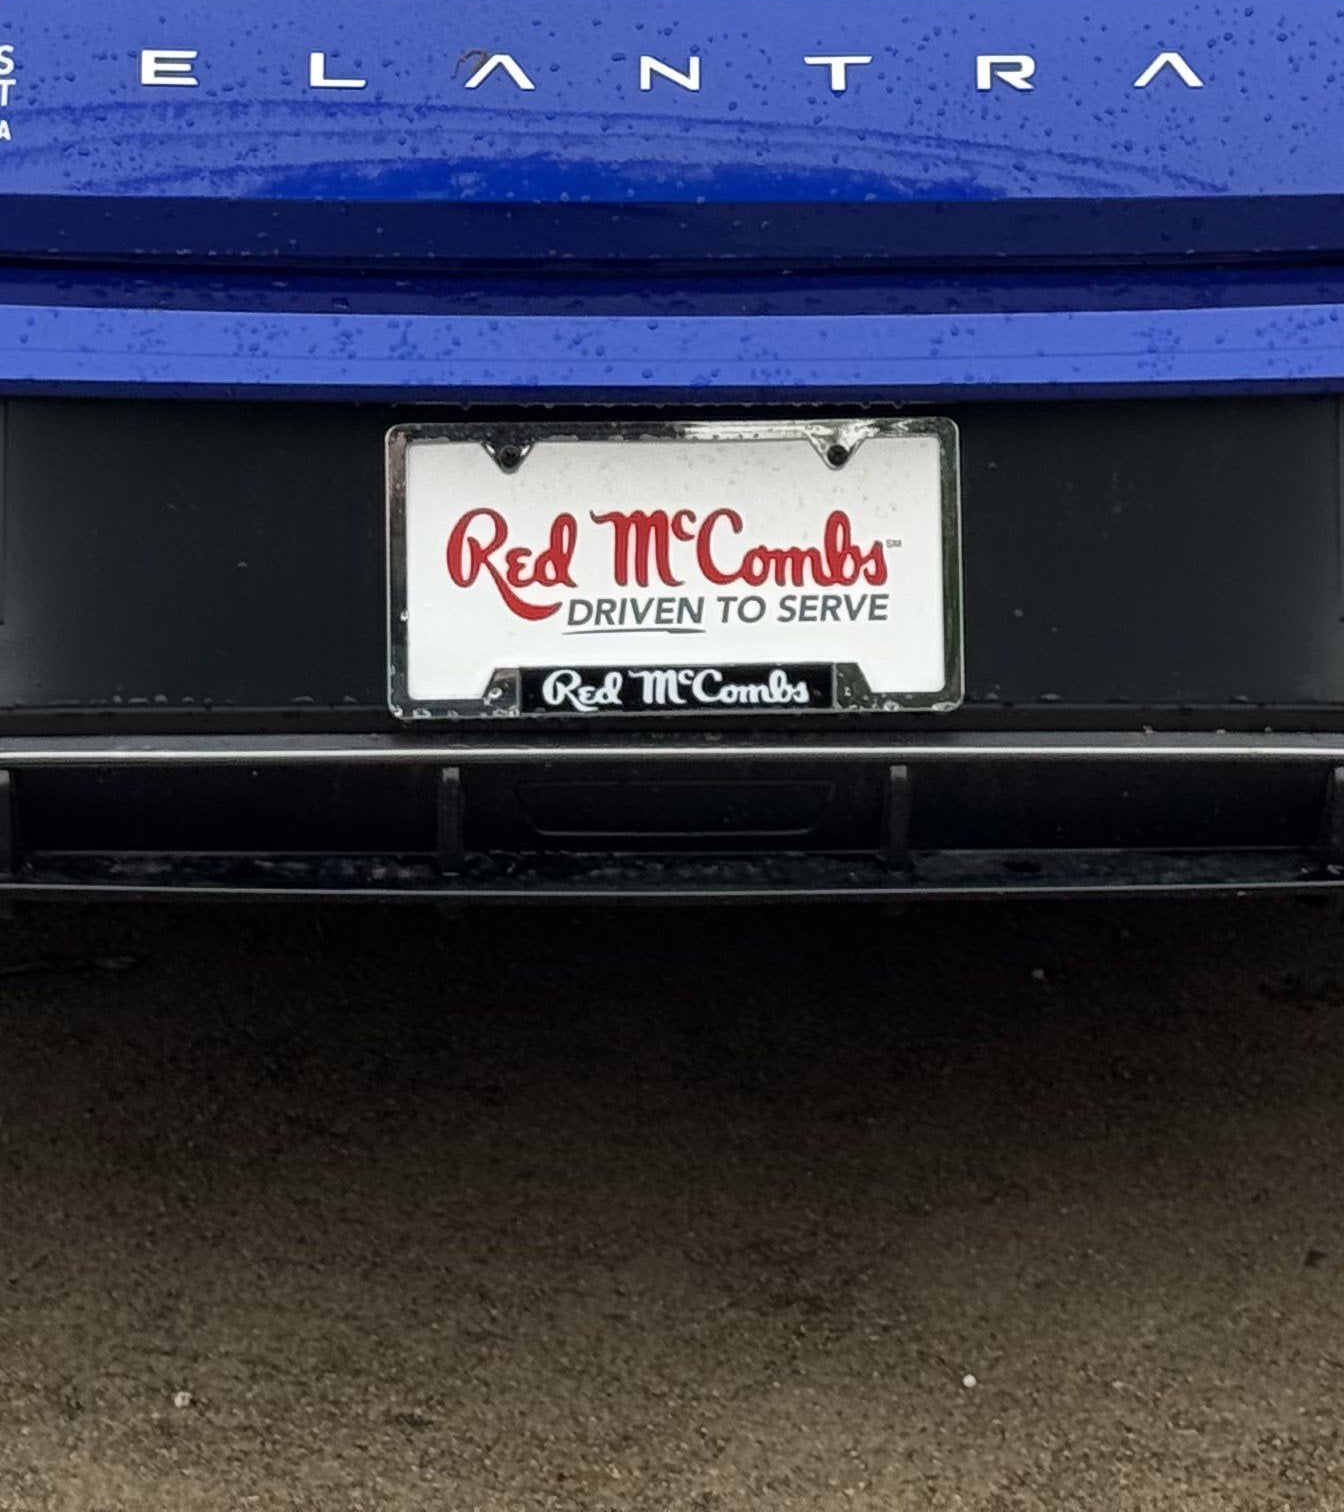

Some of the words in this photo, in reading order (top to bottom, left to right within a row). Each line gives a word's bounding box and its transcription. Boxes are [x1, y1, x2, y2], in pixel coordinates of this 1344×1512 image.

[141, 49, 1204, 91] ELANTRA
[446, 507, 579, 622] Red
[589, 507, 888, 588] McCombs
[566, 596, 705, 626] DRIVEN
[716, 594, 767, 624] TO
[776, 593, 890, 623] SERVE
[542, 669, 623, 712] Red
[627, 668, 810, 705] McCombs
